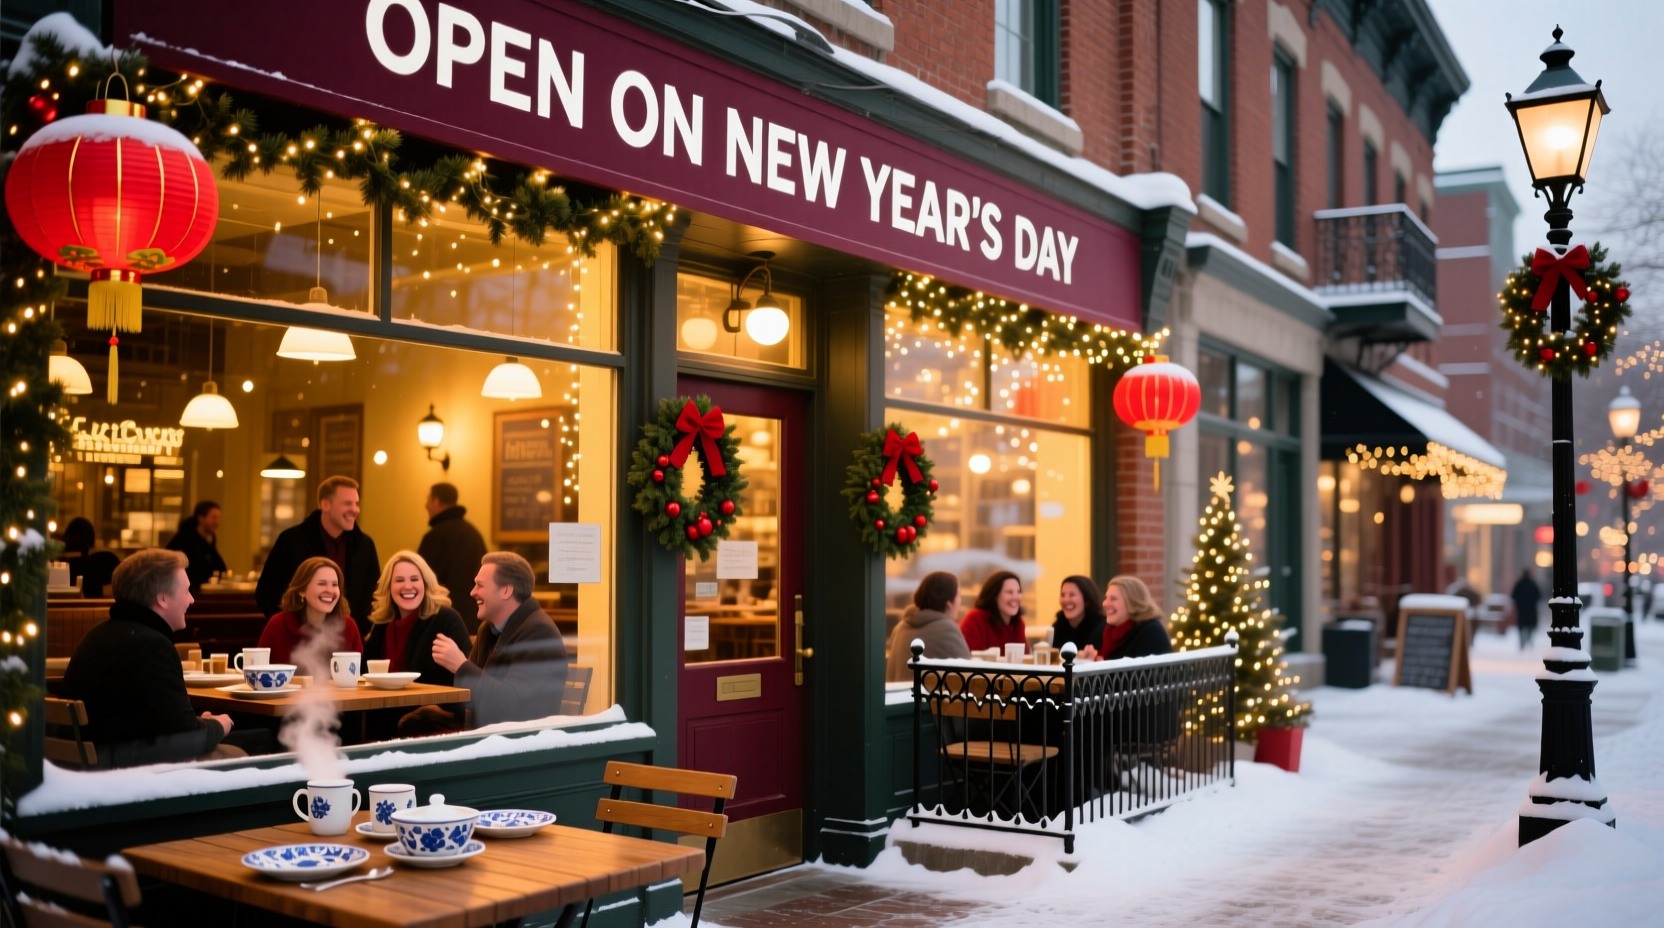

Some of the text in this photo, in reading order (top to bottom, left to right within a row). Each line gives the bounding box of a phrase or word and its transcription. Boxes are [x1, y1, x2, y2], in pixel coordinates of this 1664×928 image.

[366, 0, 1079, 285] OPEN ON NEW YEAR'S DAY
